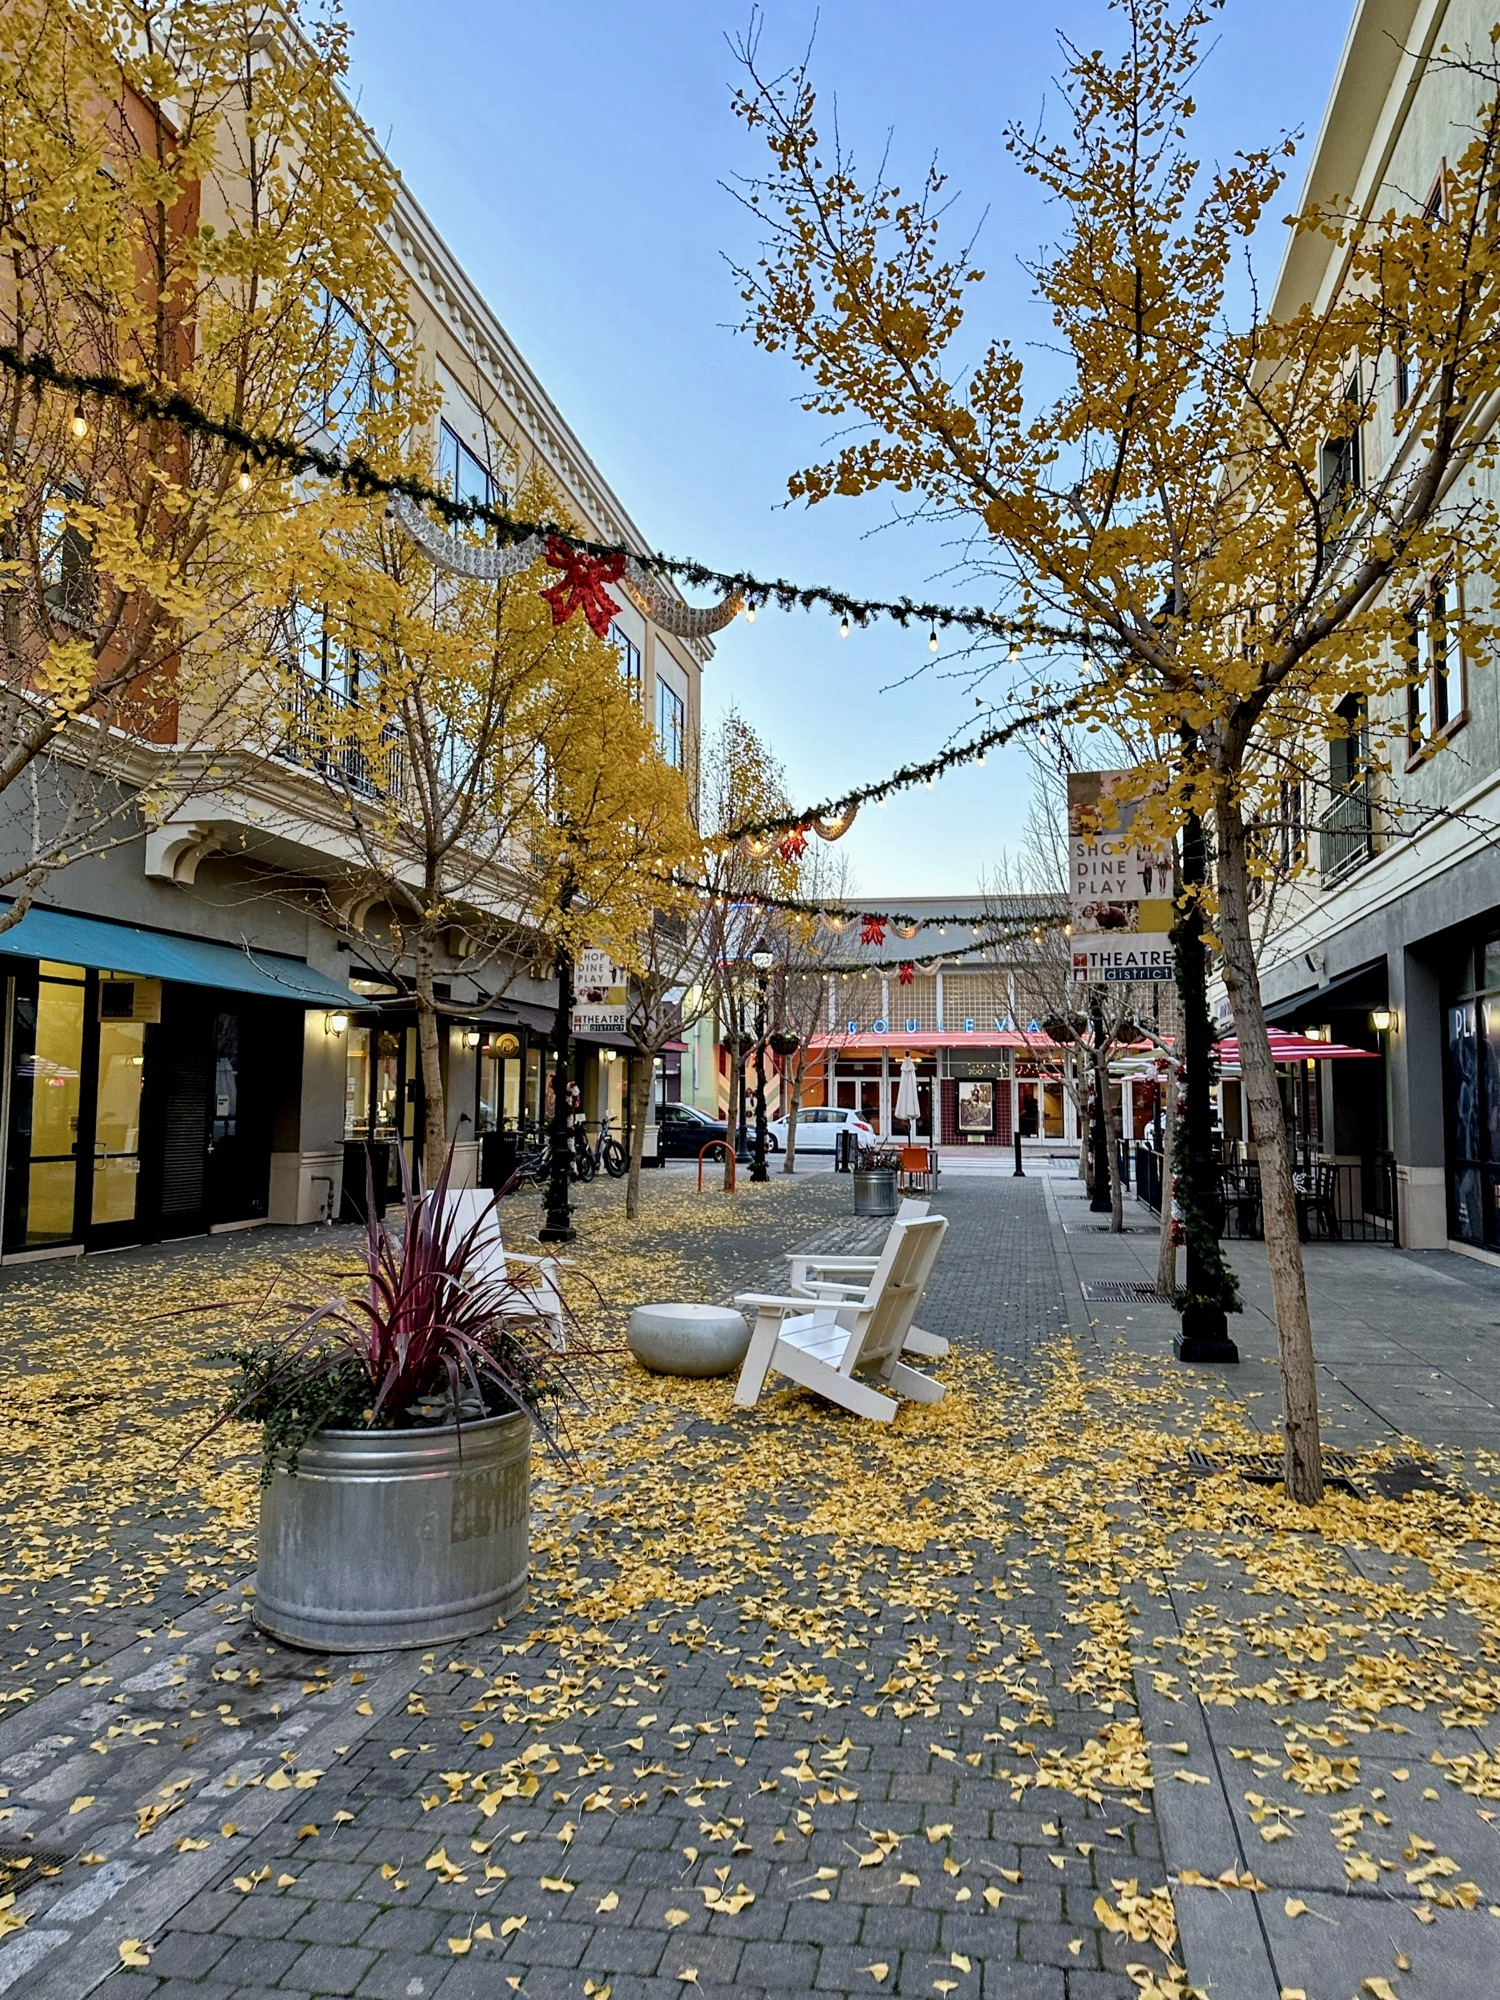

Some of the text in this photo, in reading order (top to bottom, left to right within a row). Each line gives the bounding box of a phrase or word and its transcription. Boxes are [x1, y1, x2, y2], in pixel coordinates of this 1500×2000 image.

[1077, 860, 1126, 876] DINE
[1077, 880, 1127, 895] PLAY
[580, 952, 606, 962] HOP
[1089, 951, 1172, 967] THEATRE
[578, 964, 604, 972] DINE
[1106, 967, 1170, 980] district
[578, 975, 604, 983] PLAY
[582, 1014, 625, 1024] THEATRE
[1455, 1002, 1492, 1039] PLAY
